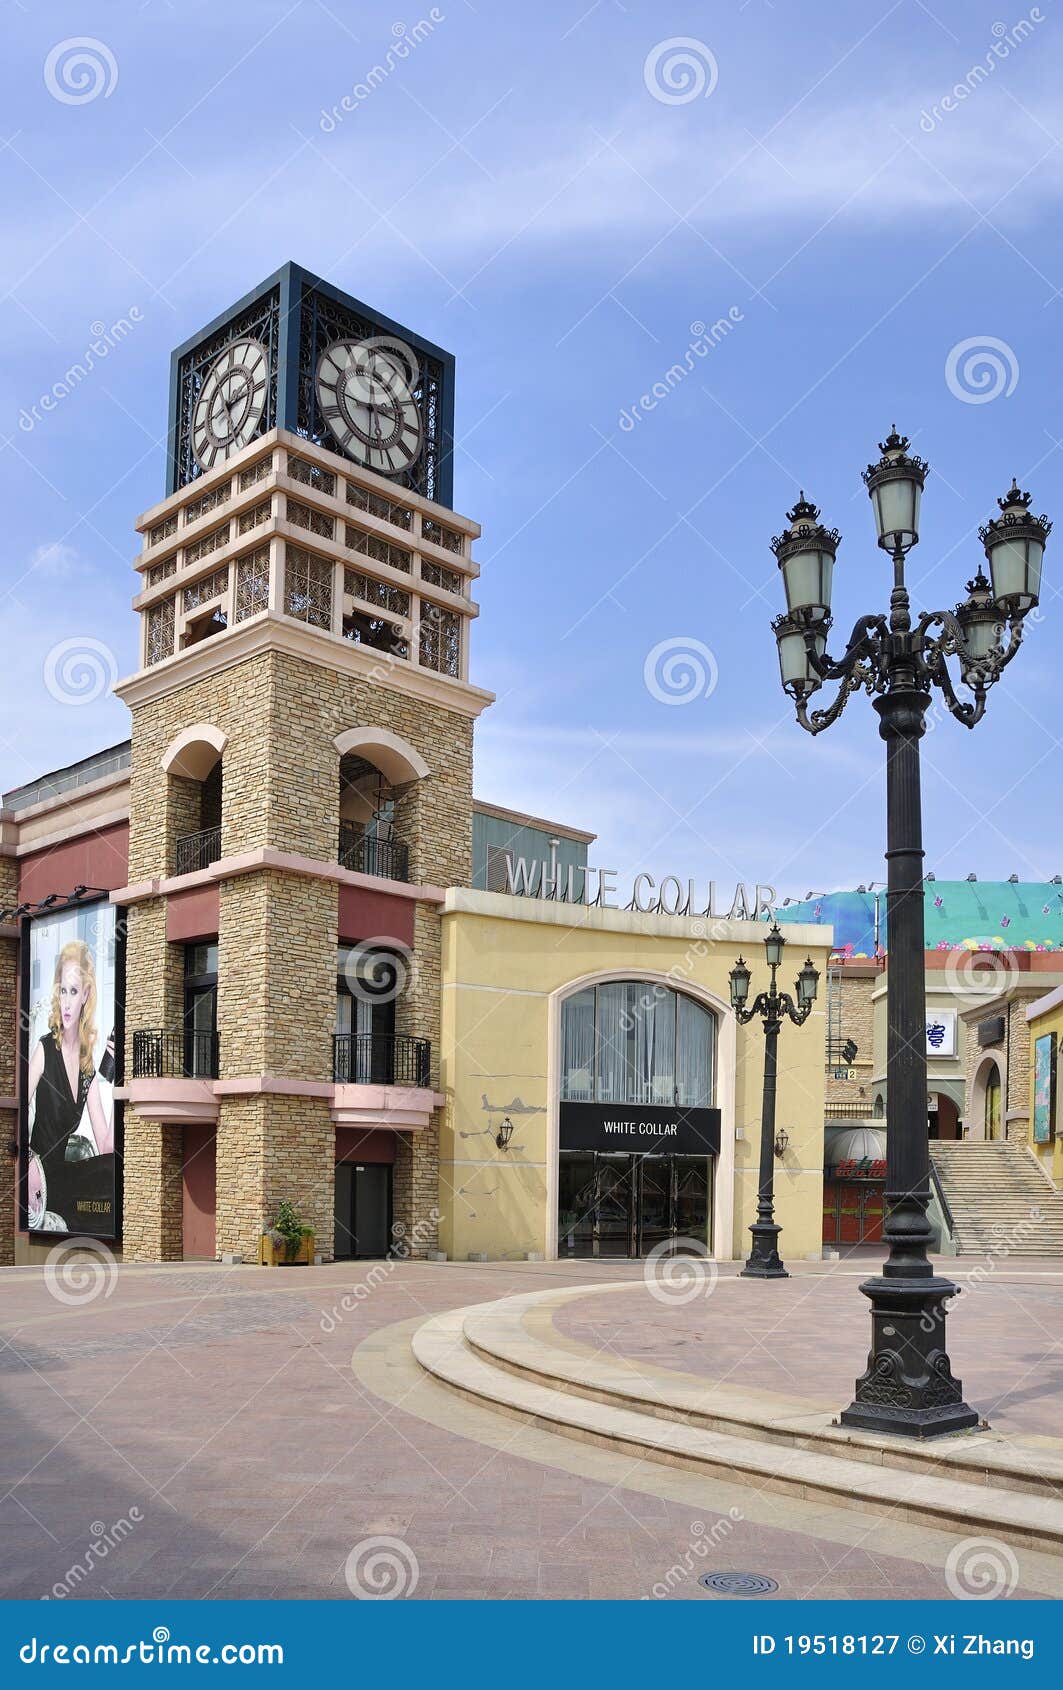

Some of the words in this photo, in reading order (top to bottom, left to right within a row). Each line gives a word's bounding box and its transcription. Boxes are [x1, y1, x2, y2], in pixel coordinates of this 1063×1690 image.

[506, 855, 620, 909] WHITE
[633, 872, 778, 922] COLLAR
[603, 1121, 636, 1135] WHITE
[638, 1122, 678, 1136] COLLAR
[77, 1201, 92, 1213] WHITE
[92, 1201, 111, 1213] COLLAR
